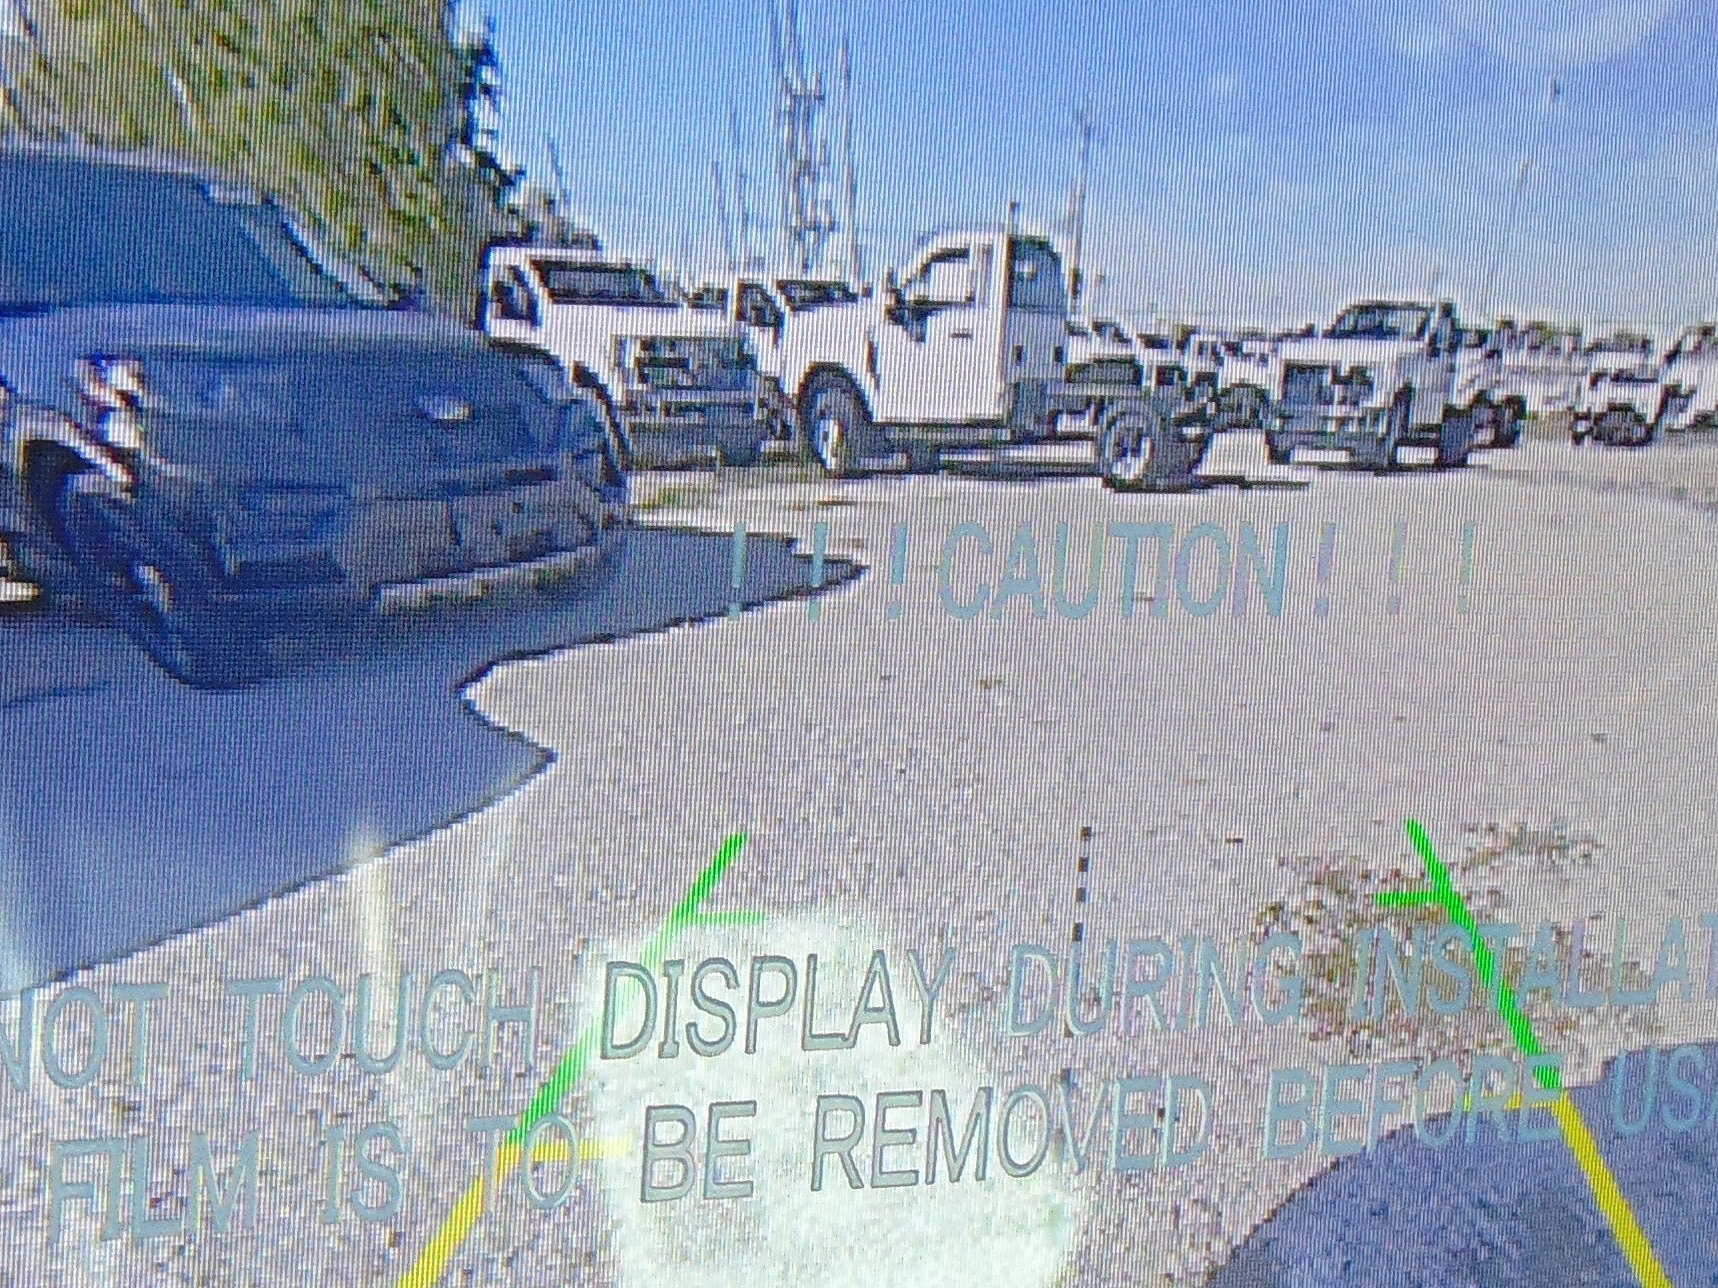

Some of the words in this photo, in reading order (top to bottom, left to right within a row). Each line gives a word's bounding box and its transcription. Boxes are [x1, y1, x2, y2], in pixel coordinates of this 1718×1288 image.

[229, 966, 540, 1081] TOUCH
[598, 946, 956, 1060] DISPLAY
[1003, 929, 1306, 1039] DURING
[44, 1130, 262, 1245] FILM
[321, 1119, 410, 1223] IS
[468, 1112, 583, 1212] TO
[639, 1100, 758, 1203] BE
[809, 1076, 1212, 1193] REMOVED
[1266, 1052, 1565, 1161] BEFORE
